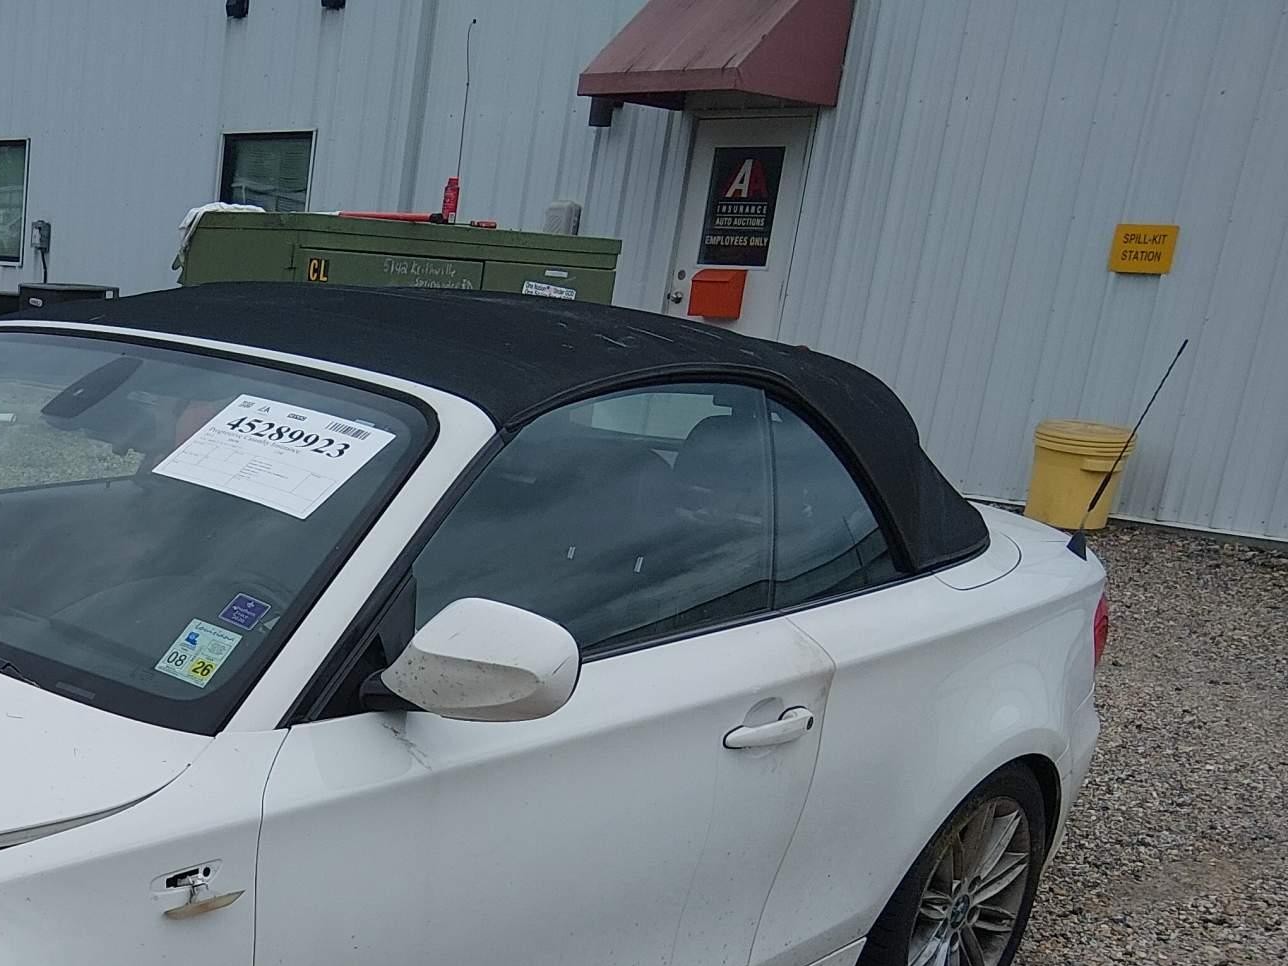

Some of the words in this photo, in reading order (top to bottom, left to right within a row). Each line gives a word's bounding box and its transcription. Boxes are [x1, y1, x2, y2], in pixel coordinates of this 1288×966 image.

[716, 204, 768, 214] INSURANCE
[715, 217, 732, 226] AUTO
[732, 217, 765, 227] AUCTIONS
[704, 235, 748, 246] EMPLOYEES
[749, 236, 769, 247] ONLY
[1122, 233, 1169, 245] SPILL-KIT
[1120, 249, 1162, 262] STATION
[309, 259, 328, 281] CL
[226, 415, 352, 459] 45289923
[194, 621, 236, 641] Louisiana
[167, 651, 188, 668] 08
[191, 660, 214, 677] 26
